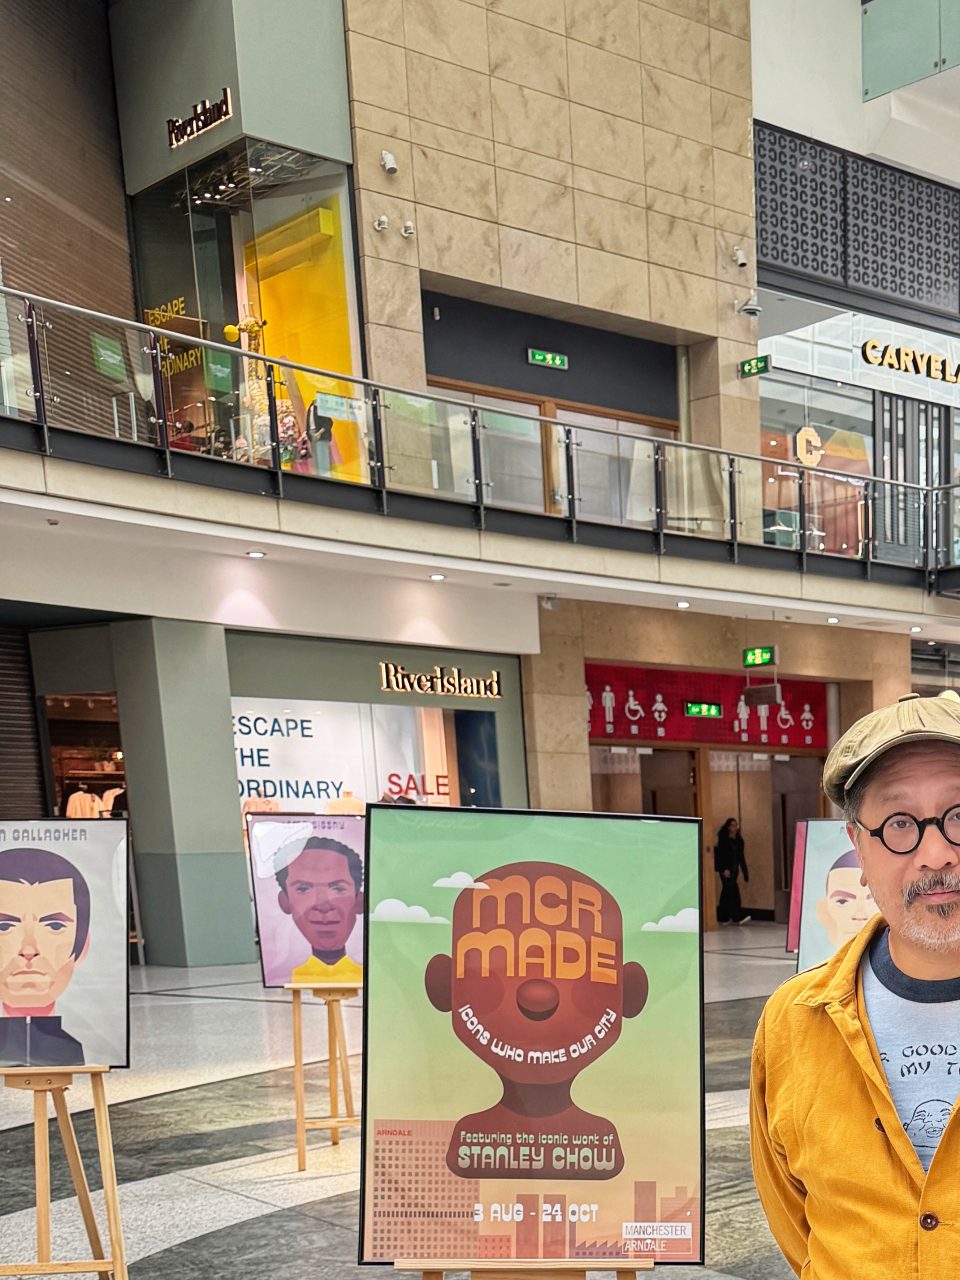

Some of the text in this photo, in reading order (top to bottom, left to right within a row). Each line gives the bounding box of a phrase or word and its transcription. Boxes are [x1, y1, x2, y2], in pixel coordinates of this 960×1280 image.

[148, 297, 185, 326] ESCAPE
[161, 347, 201, 377] RDINARY
[388, 773, 450, 796] SALE
[12, 828, 87, 841] GALLAGHER
[472, 875, 602, 934] MCR
[456, 927, 617, 985] MADE
[458, 1004, 617, 1064] ICONS WHO MAKE OUR CITY
[902, 1044, 957, 1057] GOOD
[900, 1061, 931, 1078] MY
[460, 1131, 614, 1146] Featuring the iconic work of
[458, 1145, 616, 1171] STANLEY CHOW
[473, 1203, 484, 1222] 3
[490, 1203, 524, 1222] AUG
[541, 1203, 563, 1222] 24
[568, 1203, 599, 1222] OCT
[624, 1225, 686, 1236] MANCHESTER
[624, 1239, 667, 1251] ARNDALE
